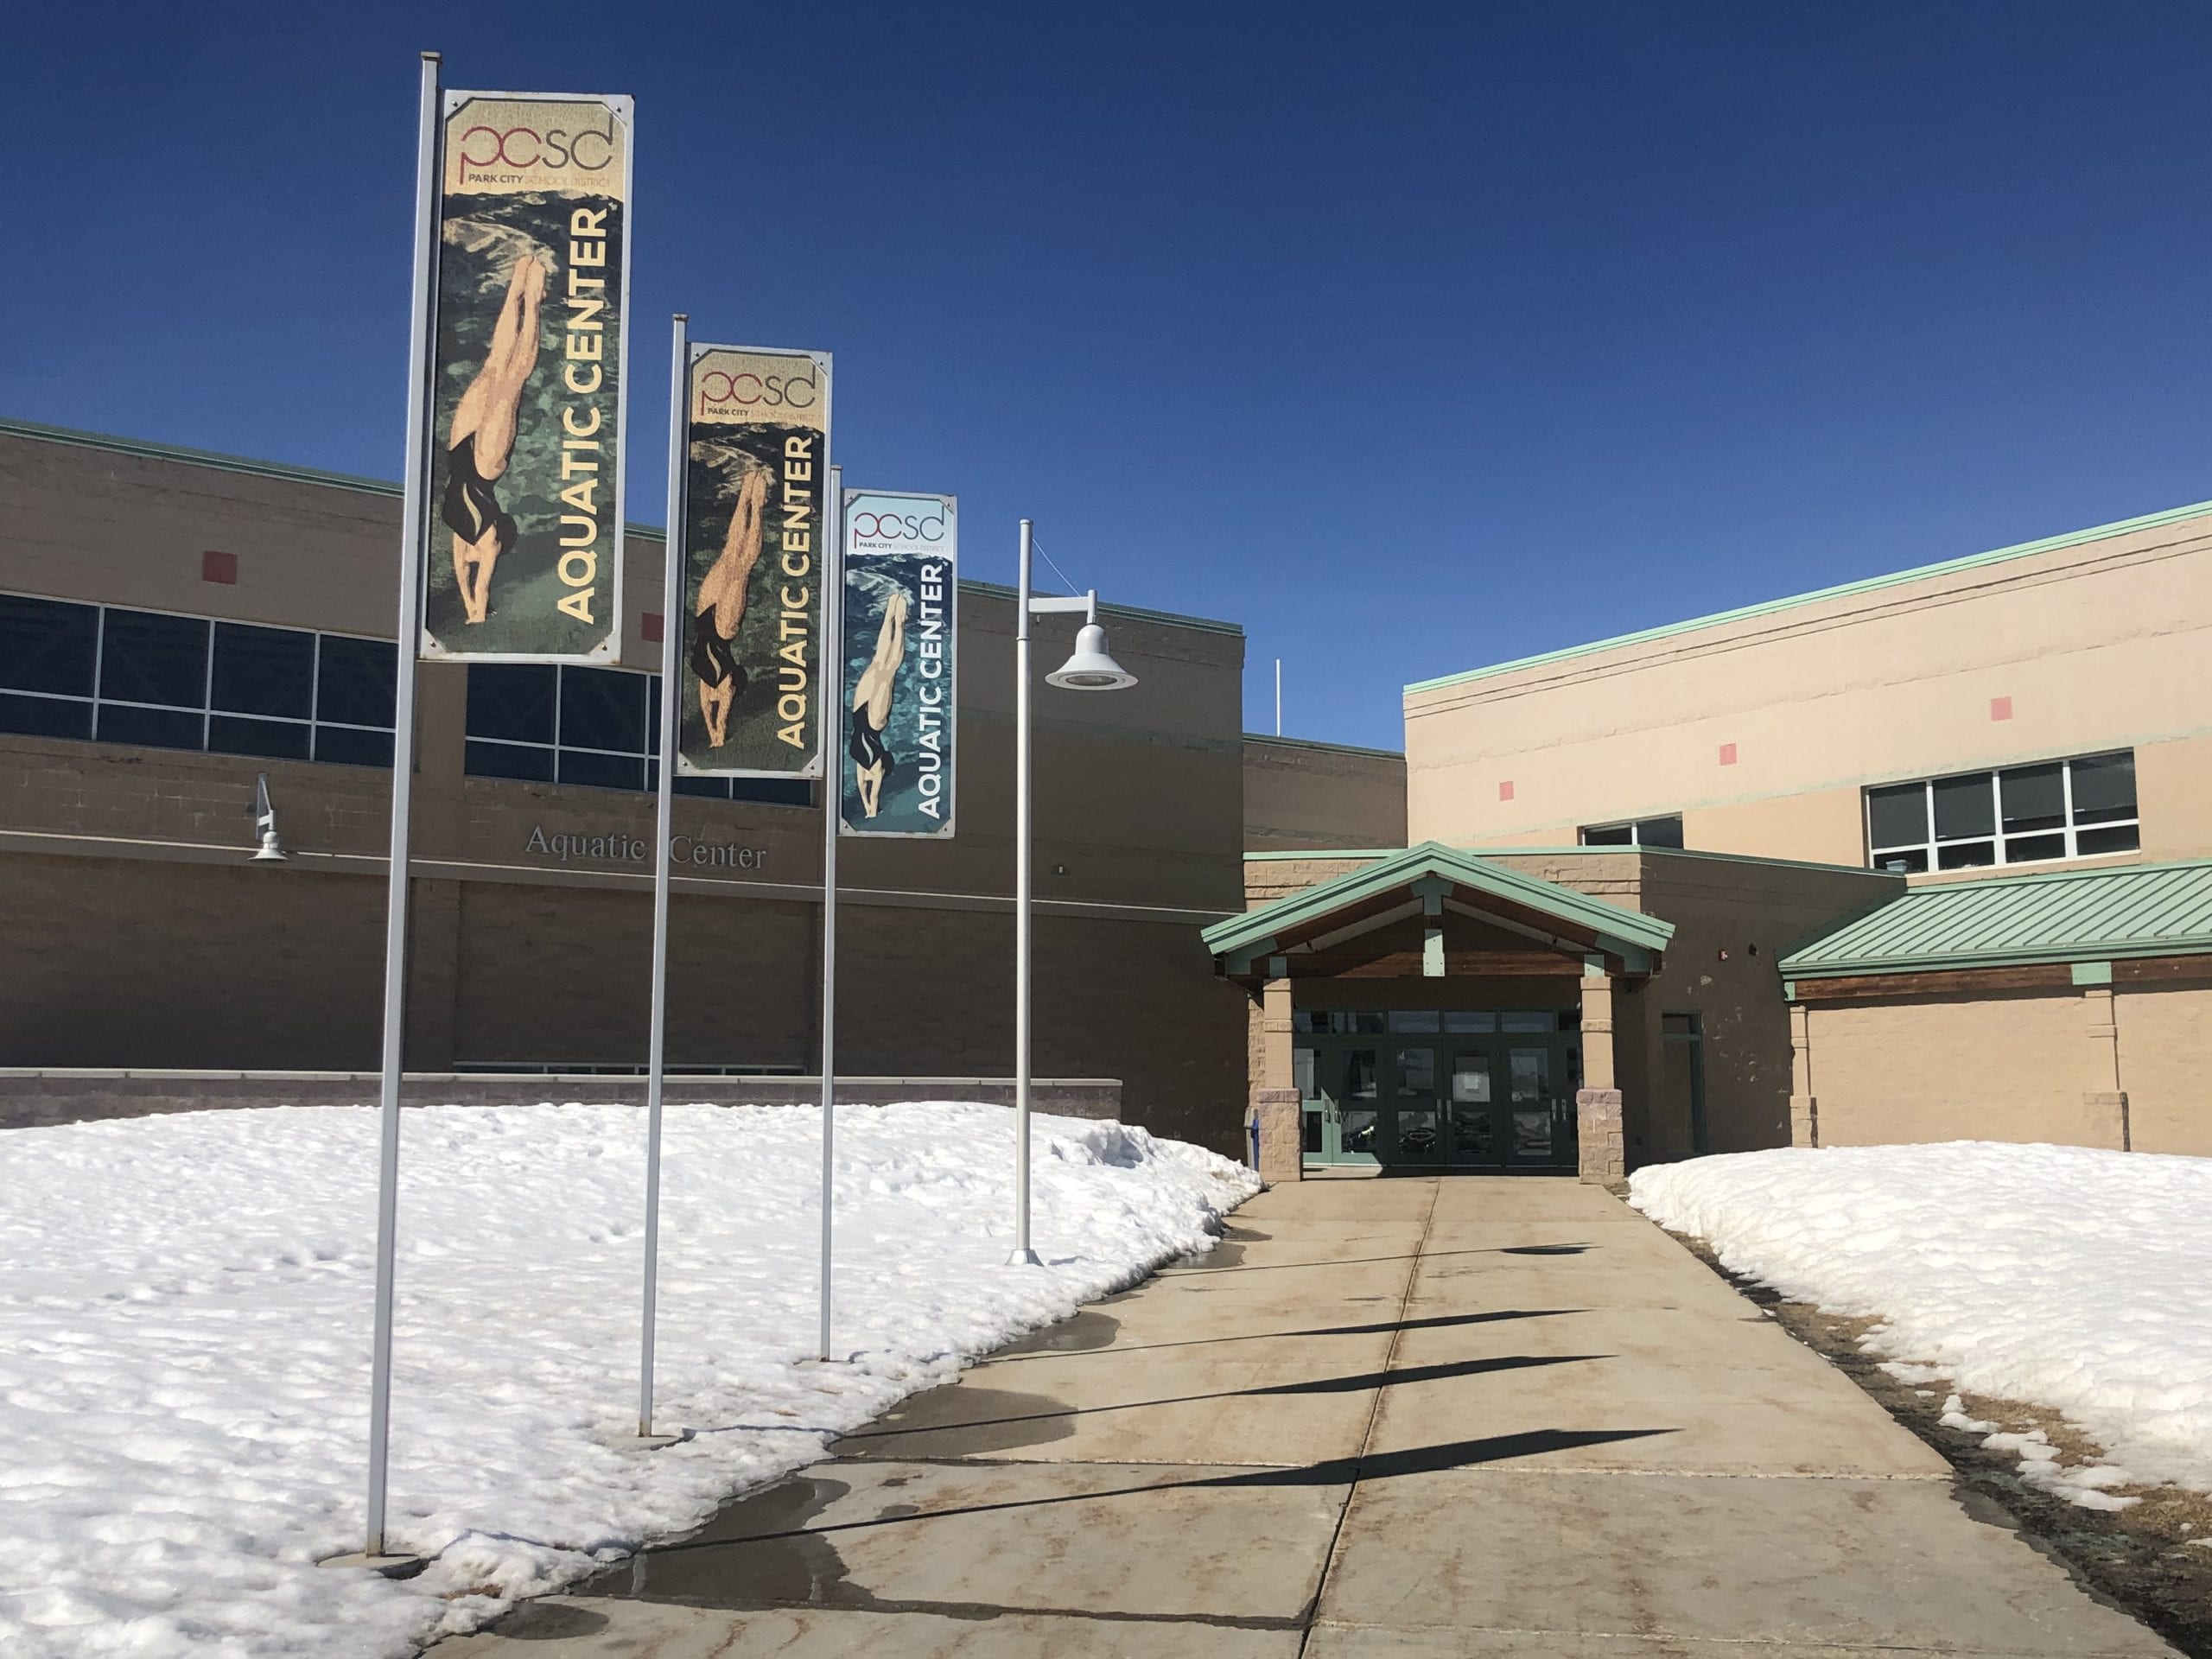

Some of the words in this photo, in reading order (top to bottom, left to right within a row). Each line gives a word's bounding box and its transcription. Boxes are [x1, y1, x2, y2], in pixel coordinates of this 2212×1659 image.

[468, 174, 498, 183] PARK
[499, 175, 524, 184] CITY
[564, 208, 608, 394] CENTER
[708, 407, 729, 416] PARK
[557, 407, 601, 625] AQUATIC
[781, 435, 813, 577] CENTER
[777, 586, 810, 750] AQUATIC
[919, 564, 943, 679] CENTER
[918, 686, 942, 820] AQUATIC
[524, 824, 646, 861] Aquatic
[669, 835, 767, 869] Center
